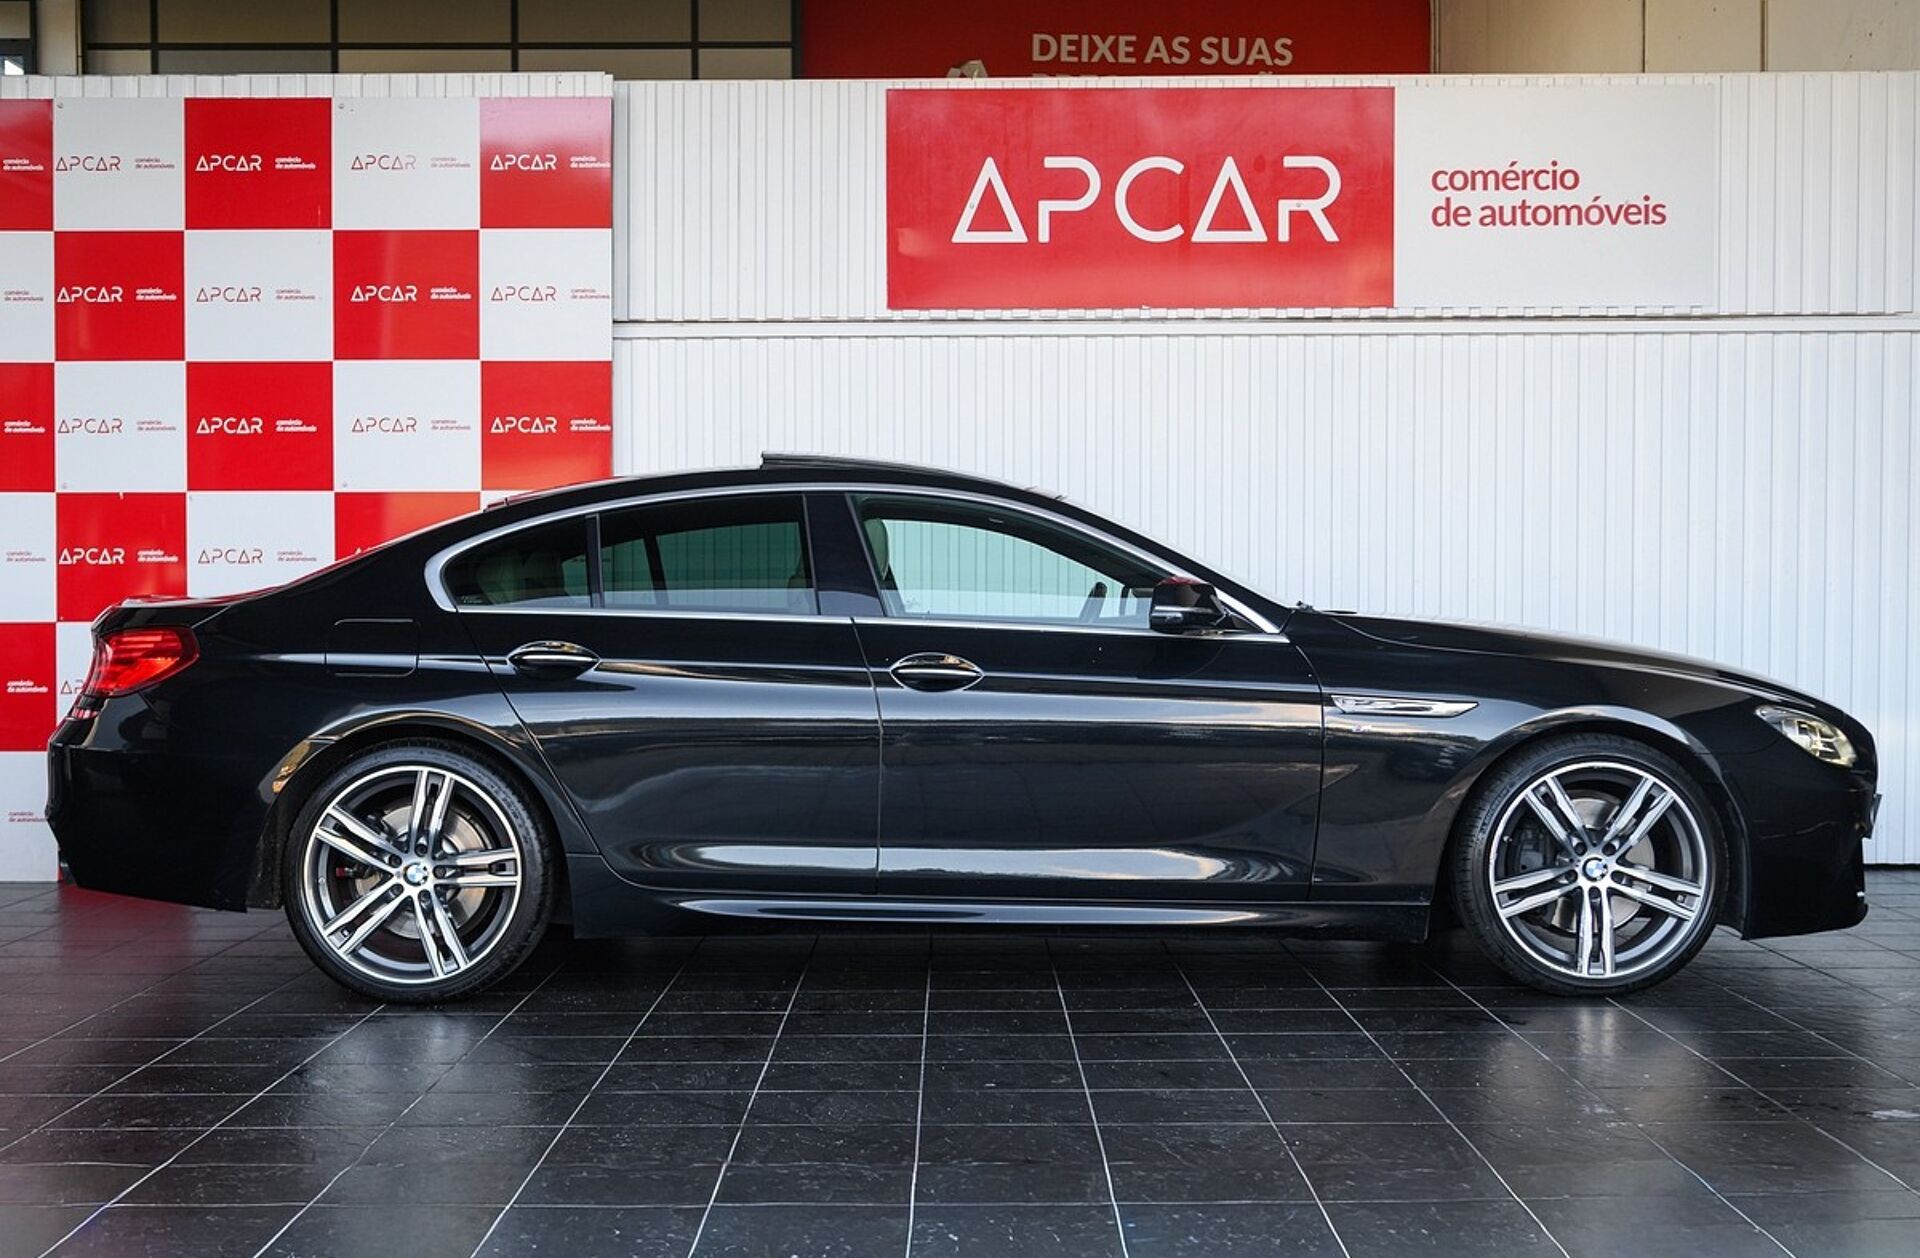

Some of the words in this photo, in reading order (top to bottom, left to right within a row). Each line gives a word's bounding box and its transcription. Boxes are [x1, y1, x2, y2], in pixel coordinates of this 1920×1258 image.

[1032, 33, 1136, 63] DEIXE
[1144, 36, 1190, 65] AS
[1200, 37, 1293, 66] SUAS
[56, 156, 121, 172] APCAR
[195, 155, 262, 172] APCAR
[351, 155, 416, 170] APCAR
[490, 154, 557, 171] APCAR
[1431, 160, 1579, 191] comércio
[951, 155, 1342, 244] APCAR
[1431, 197, 1471, 227] de
[1479, 195, 1667, 227] automóveis
[57, 286, 123, 303] APCAR
[196, 287, 262, 302] APCAR
[351, 285, 417, 302] APCAR
[491, 286, 556, 301] APCAR
[57, 418, 122, 434] APCAR
[196, 417, 263, 435] APCAR
[352, 417, 417, 432] APCAR
[491, 416, 557, 433] APCAR
[58, 547, 125, 565] APCAR
[198, 549, 264, 564] APCAR
